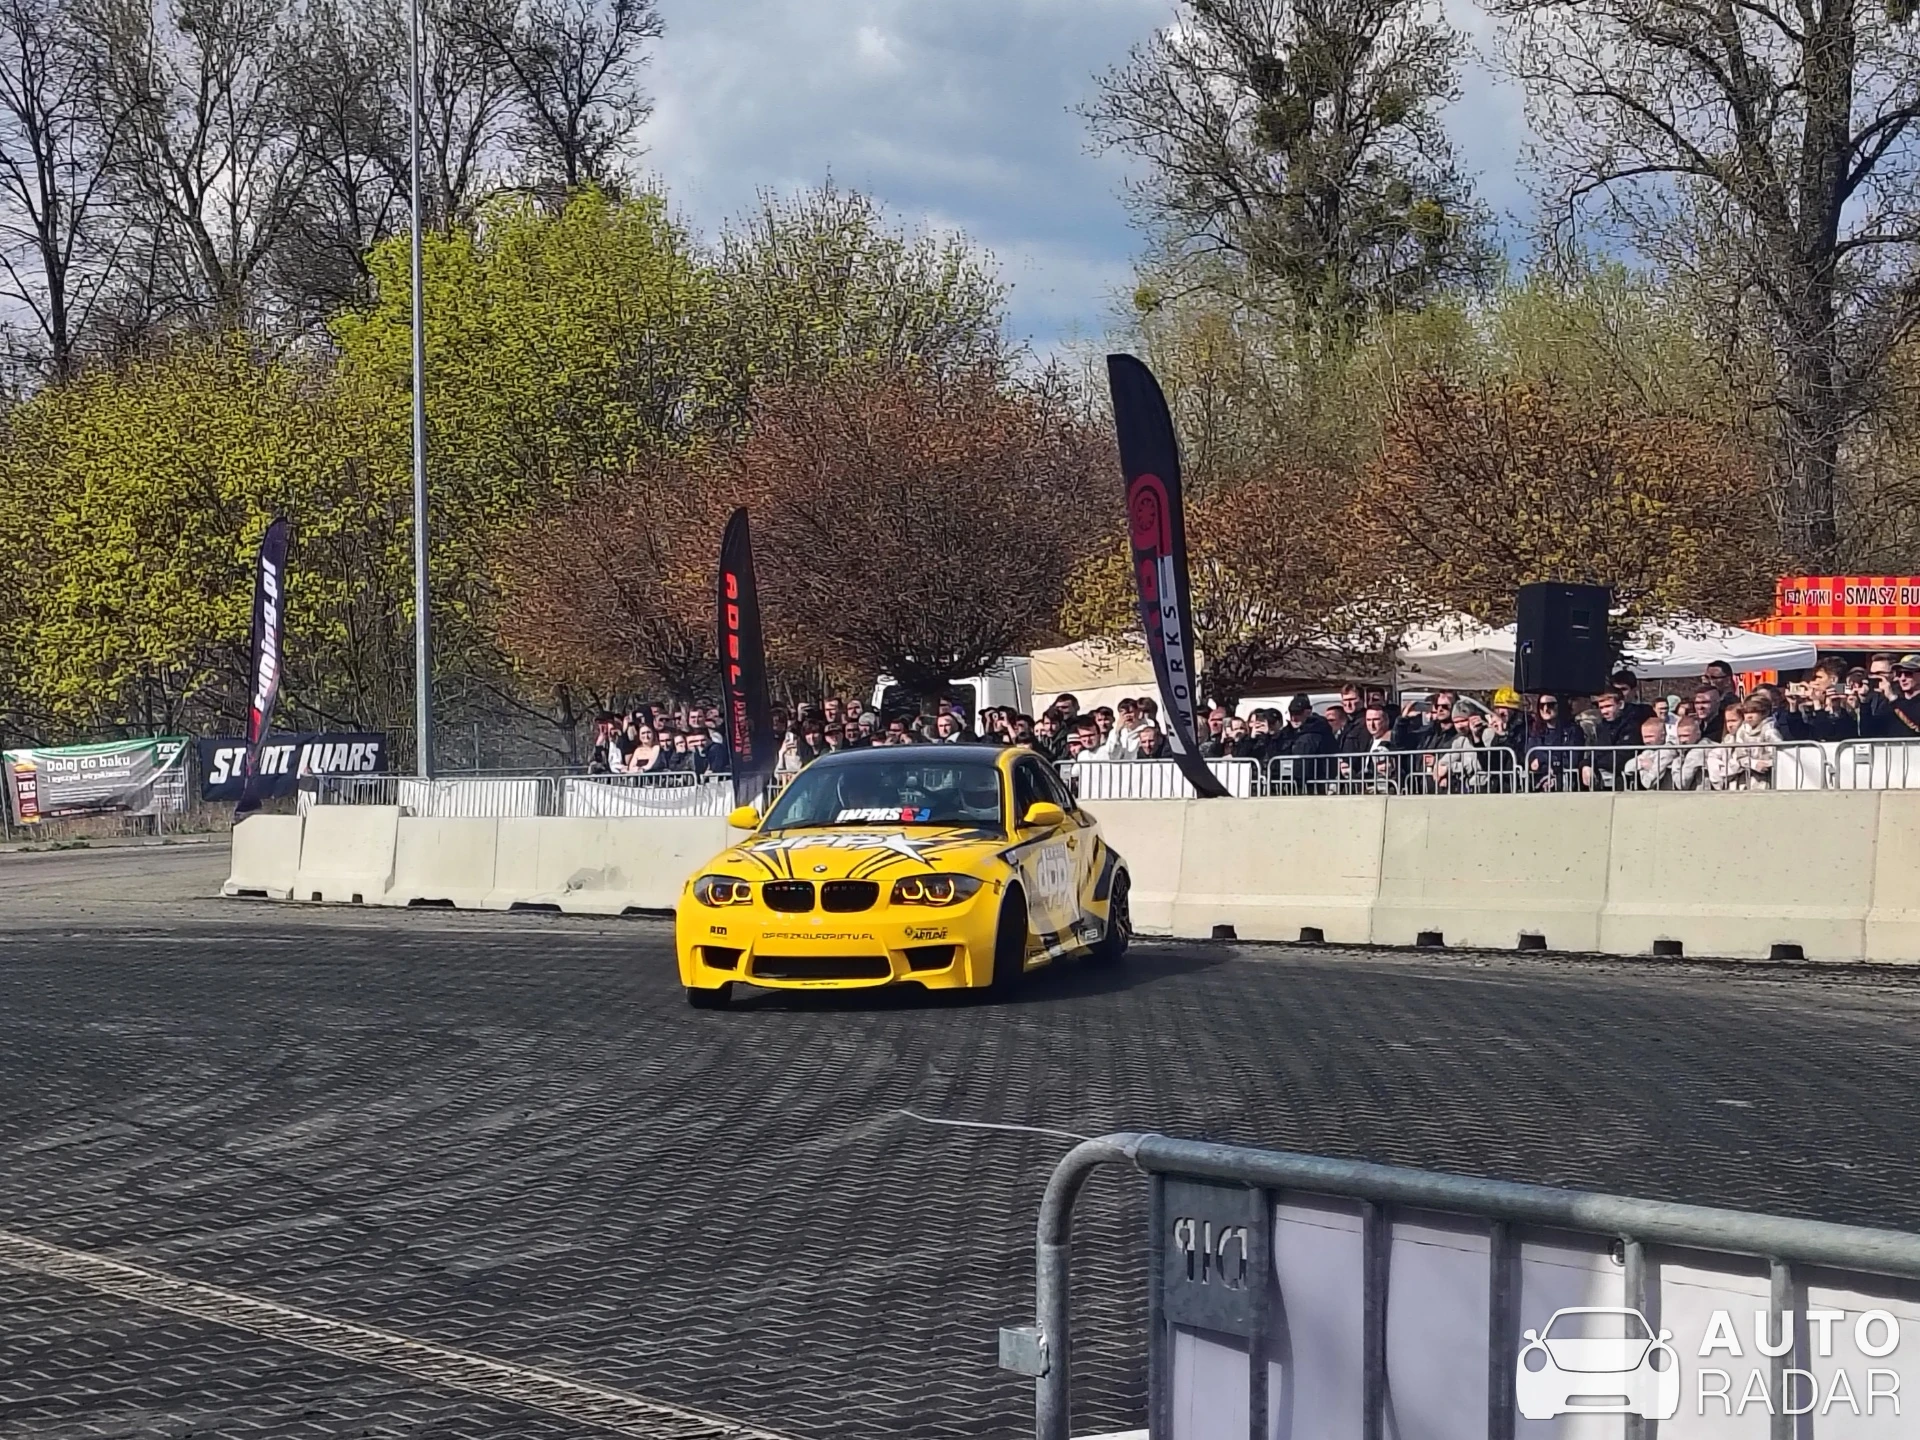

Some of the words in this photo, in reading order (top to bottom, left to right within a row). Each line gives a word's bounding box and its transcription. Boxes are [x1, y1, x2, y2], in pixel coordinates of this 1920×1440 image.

[1846, 587, 1896, 605] SMASZ
[1163, 605, 1192, 727] WORKS
[46, 759, 78, 773] Dolej
[80, 758, 97, 769] do
[99, 755, 131, 768] baku
[209, 745, 296, 785] STNT
